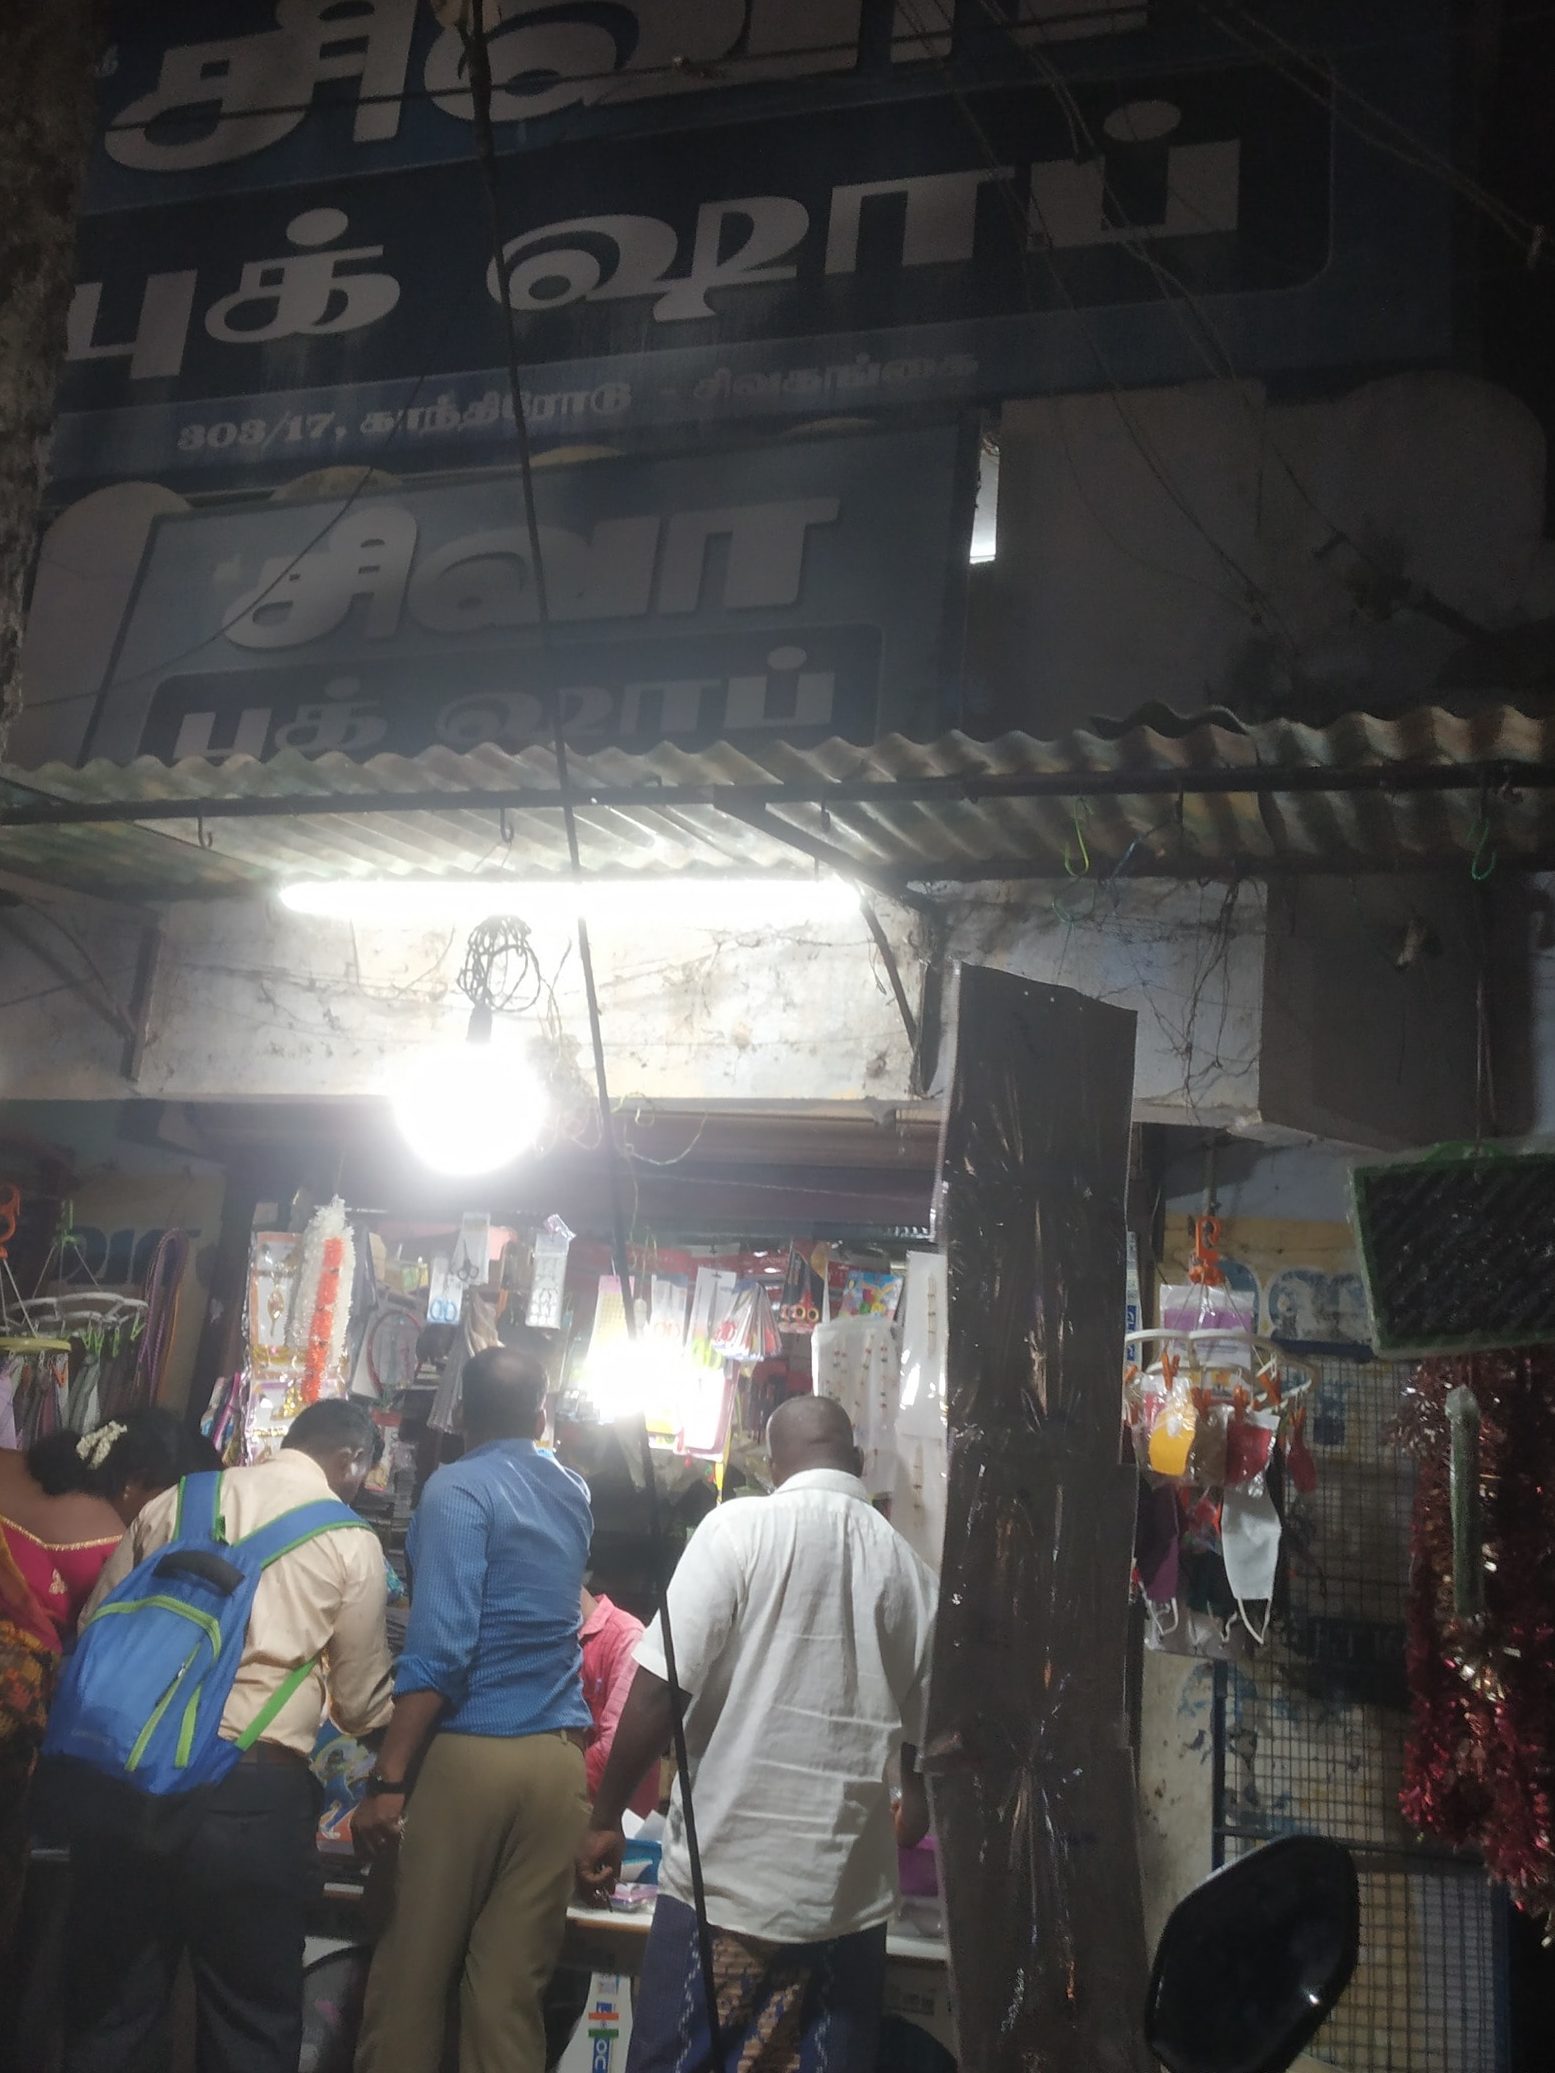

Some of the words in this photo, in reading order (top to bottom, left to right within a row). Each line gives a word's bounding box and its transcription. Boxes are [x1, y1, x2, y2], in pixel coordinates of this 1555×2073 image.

[66, 208, 400, 379] புக்
[486, 100, 1240, 323] ஷாப்
[220, 502, 841, 650] சிவா
